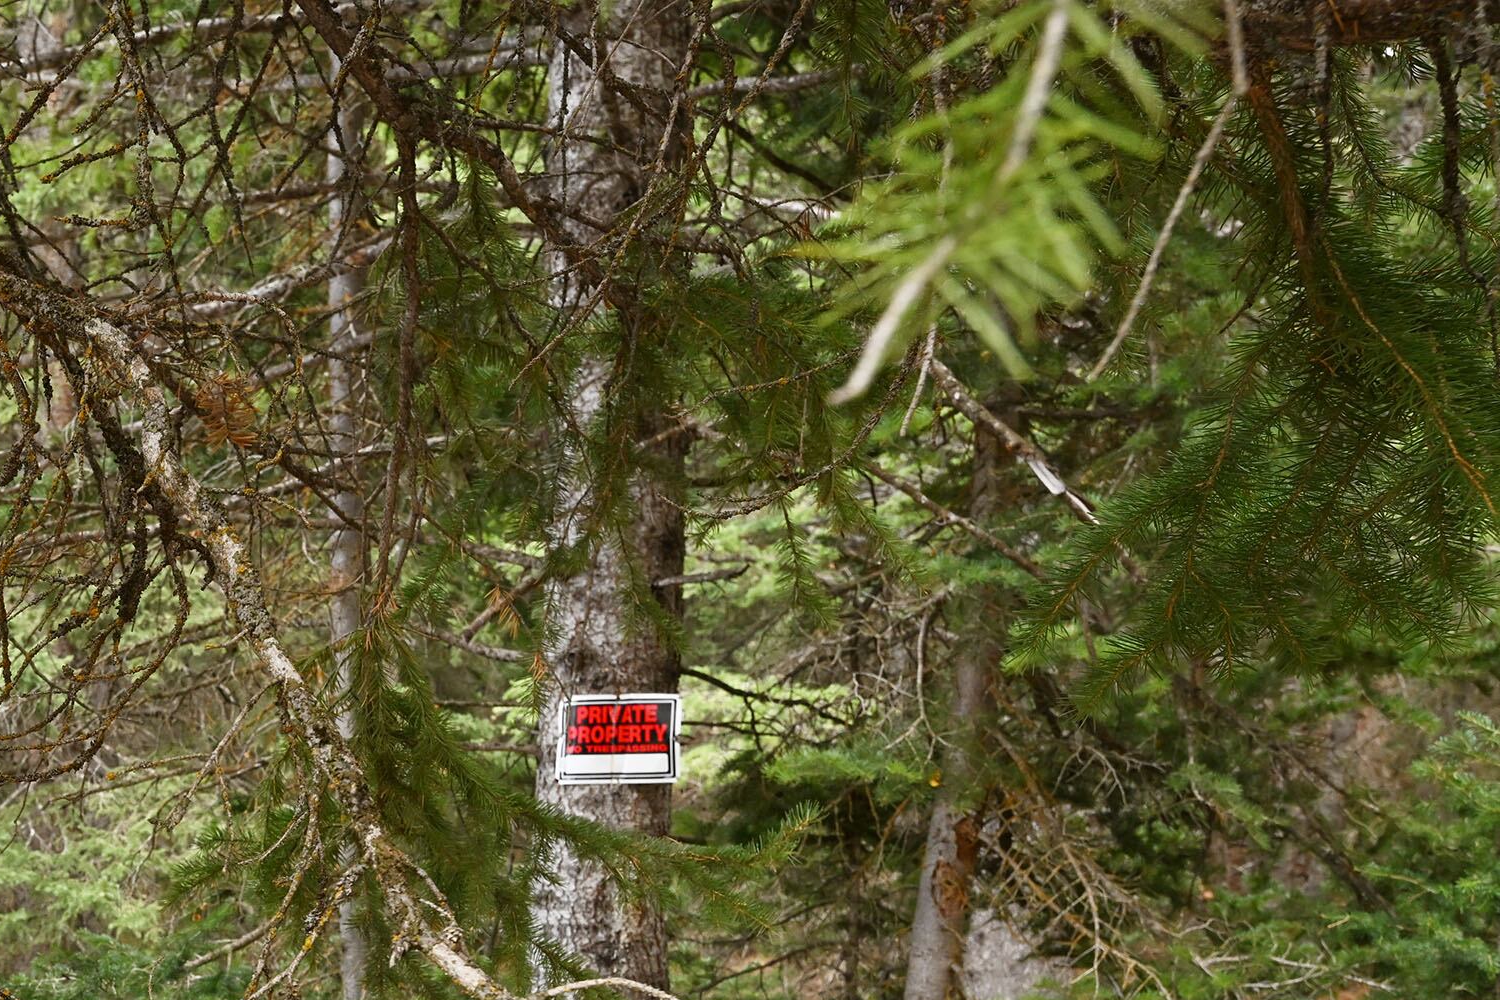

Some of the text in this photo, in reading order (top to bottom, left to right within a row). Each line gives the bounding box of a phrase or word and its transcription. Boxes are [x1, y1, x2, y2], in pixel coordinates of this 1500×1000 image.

[576, 704, 658, 724] PRIVATE
[568, 724, 667, 743] PROPERTY
[586, 744, 668, 753] TRESPASSING
